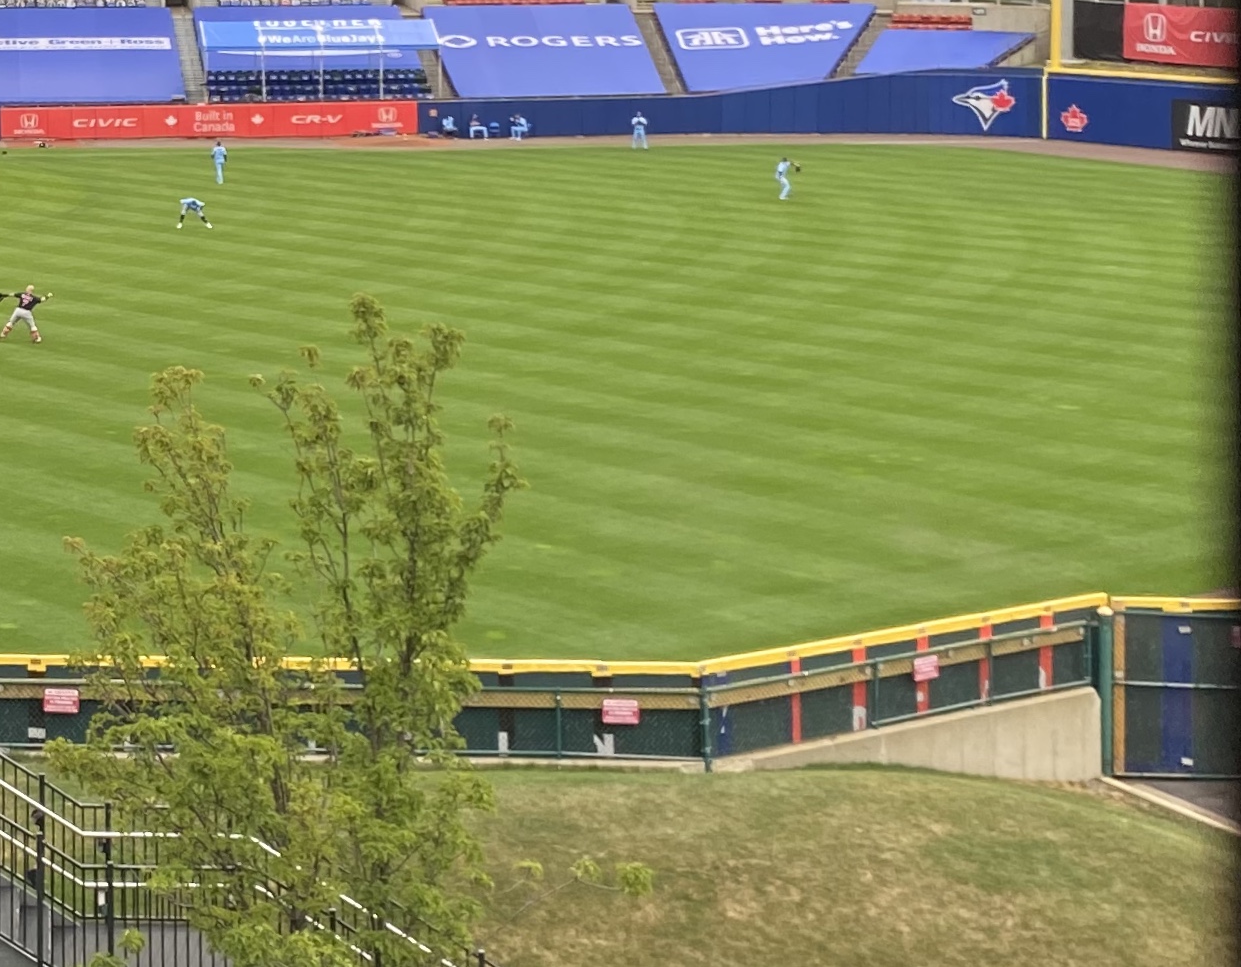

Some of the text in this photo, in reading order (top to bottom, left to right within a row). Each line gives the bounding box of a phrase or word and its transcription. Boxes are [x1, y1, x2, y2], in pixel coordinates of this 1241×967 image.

[754, 19, 854, 36] Here's
[485, 35, 643, 47] ROGERS
[759, 33, 840, 46] How.
[195, 111, 233, 121] Built in
[290, 114, 343, 124] CR-V
[73, 118, 138, 128] CIVIC
[193, 122, 235, 132] Canada
